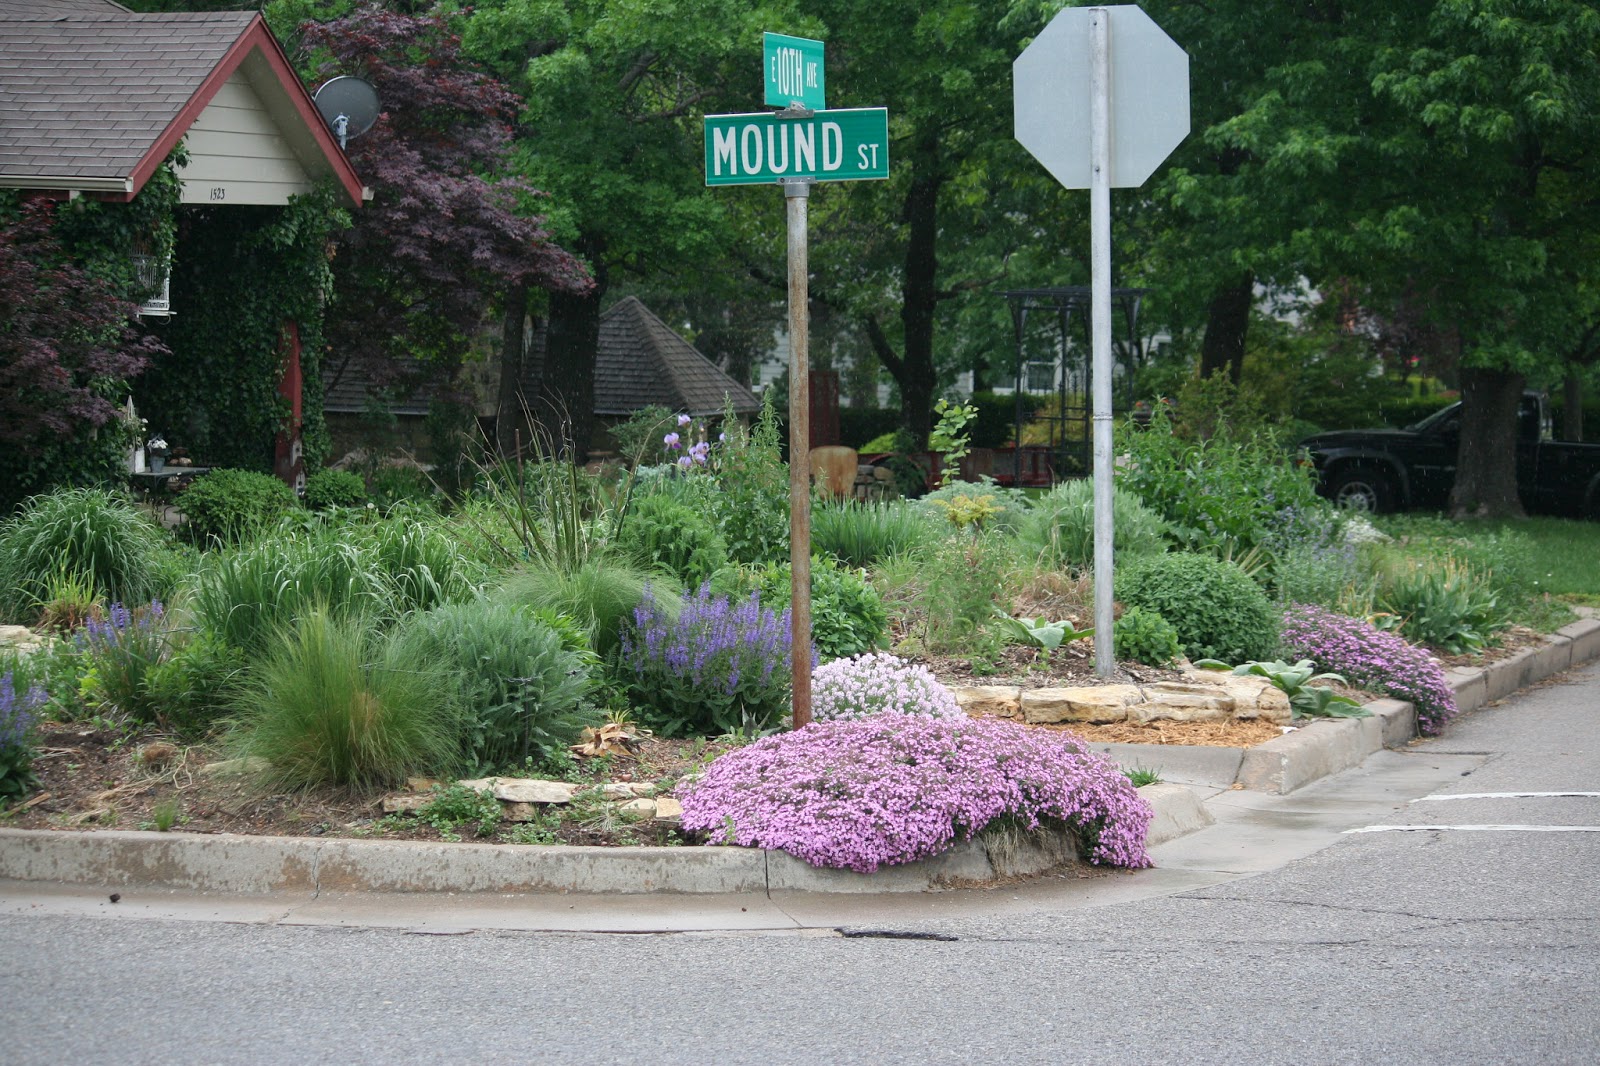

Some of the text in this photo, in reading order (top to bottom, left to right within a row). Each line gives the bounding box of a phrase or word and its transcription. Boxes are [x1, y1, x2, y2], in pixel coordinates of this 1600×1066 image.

[772, 46, 817, 97] E 10TH AVE
[713, 122, 879, 176] MOUND ST
[210, 187, 225, 200] 1523
